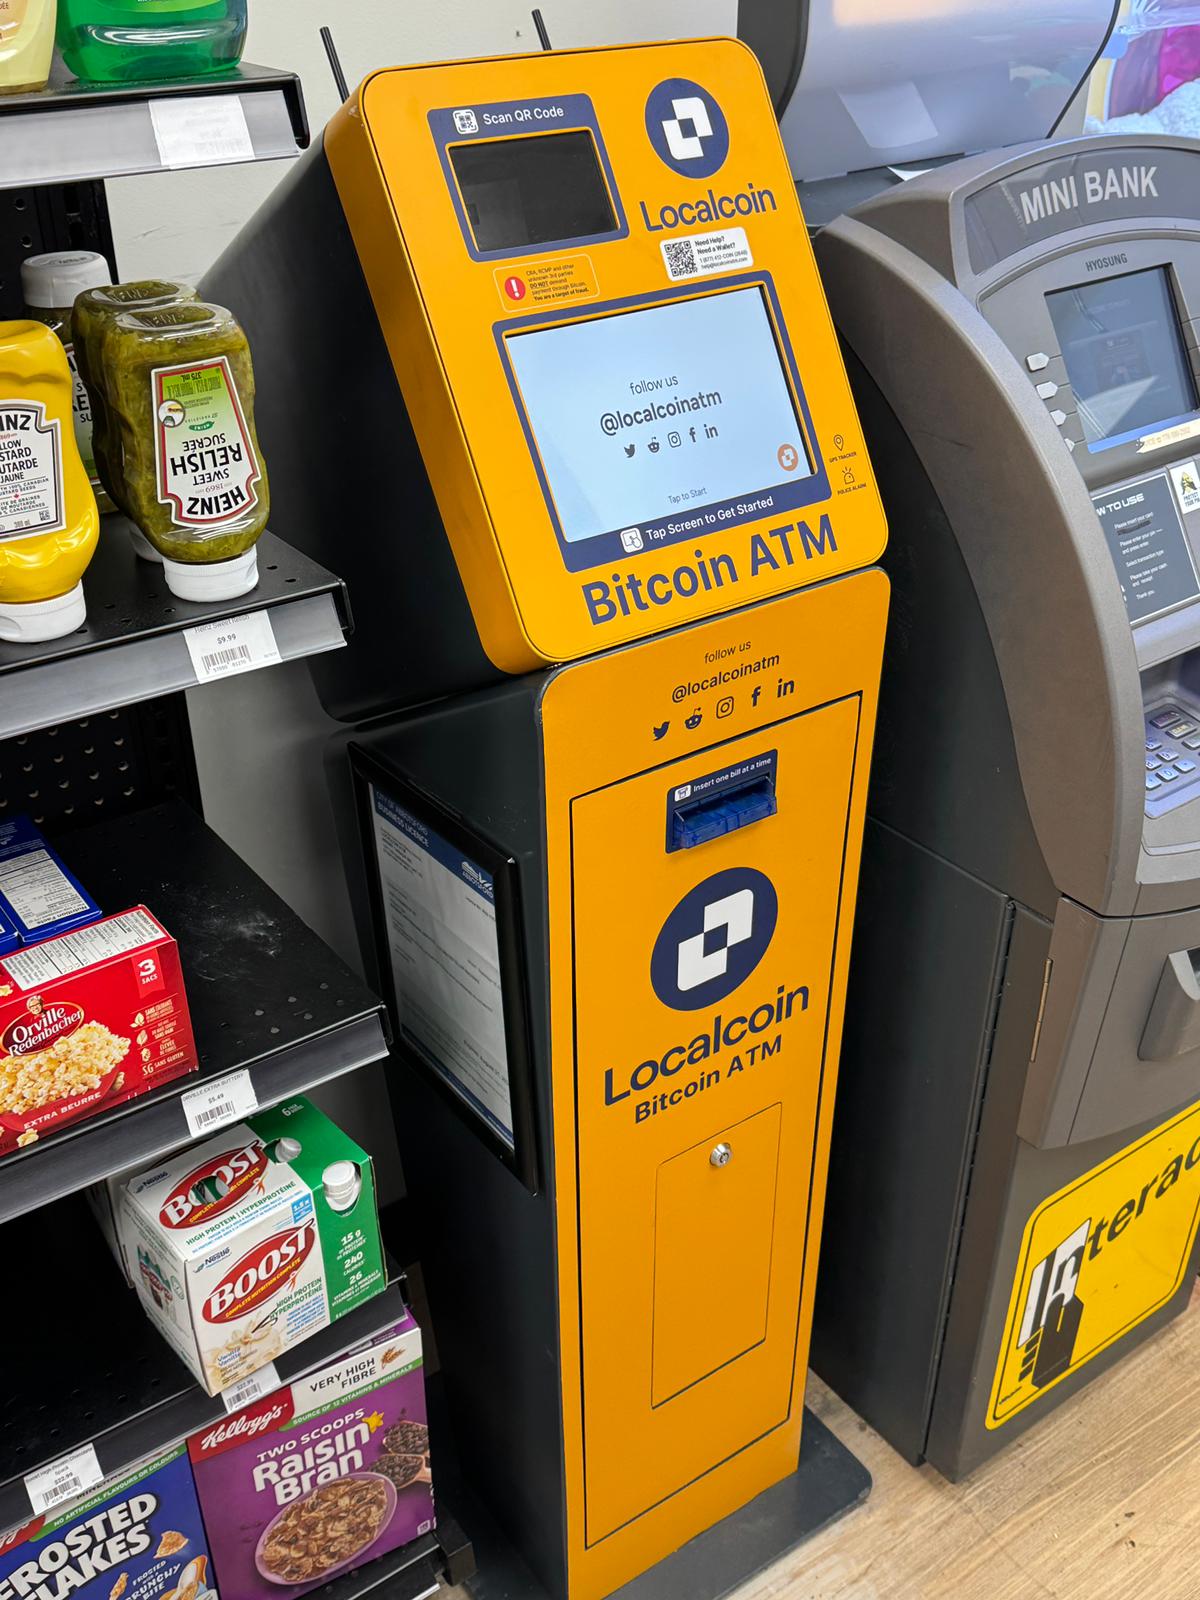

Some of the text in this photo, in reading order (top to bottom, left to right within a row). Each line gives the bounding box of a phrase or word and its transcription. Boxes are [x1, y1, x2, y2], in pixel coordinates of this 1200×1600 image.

[483, 105, 564, 125] Scan QR Code
[1020, 166, 1159, 225] MINI BANK
[639, 183, 777, 232] Localcoin
[694, 239, 710, 247] Need
[697, 247, 712, 255] Need
[1085, 253, 1128, 272] HYOSUNG
[190, 371, 202, 380] 375
[629, 375, 679, 395] follow us
[0, 413, 31, 431] INZ
[600, 391, 722, 436] @localcoinatm
[182, 433, 226, 453] SUCRÉE
[0, 447, 32, 462] STARD
[170, 443, 243, 476] RELISH
[0, 458, 39, 474] UTARDE
[0, 472, 25, 484] JAUNE
[193, 468, 230, 486] SWEET
[205, 483, 223, 493] 1869
[668, 487, 708, 504] Tap to Start
[187, 485, 246, 515] HEINZ
[1106, 493, 1145, 512] TO USE
[645, 496, 774, 541] Tap Screen to Get Started
[581, 513, 838, 626] Bitcoin ATM
[217, 633, 237, 644] $9.99
[704, 641, 752, 664] follow us
[672, 654, 780, 703] @localcoinatm
[693, 779, 714, 792] Insert
[715, 774, 730, 783] one
[730, 768, 741, 778] bill
[742, 765, 749, 774] at
[756, 758, 772, 768] time
[137, 959, 156, 977] 3
[141, 974, 158, 985] SACS
[8, 1011, 81, 1057] Redenbacher
[12, 1008, 66, 1043] Orville
[605, 984, 809, 1106] Localcoin
[142, 1062, 154, 1076] SG
[155, 1059, 167, 1068] SANS
[635, 1034, 782, 1124] Bitcoin ATM
[208, 1093, 224, 1104] $5.49
[23, 1111, 58, 1129] EXTRA
[60, 1091, 102, 1113] BEURRE
[282, 1107, 290, 1117] 6
[143, 1171, 168, 1187] Nestlé
[185, 1232, 205, 1246] HIGH
[206, 1216, 235, 1236] PROTEIN
[341, 1232, 353, 1244] 15
[204, 1247, 231, 1265] Nestlé
[344, 1251, 363, 1269] 240
[210, 1218, 315, 1320] BOOST
[349, 1271, 362, 1284] 26
[276, 1277, 322, 1308] HIGH PROTEIN
[225, 1298, 250, 1318] COMPLETE
[310, 1357, 375, 1392] VERY HIGH
[341, 1366, 377, 1389] FIBRE
[293, 1407, 321, 1426] SOURCE
[322, 1404, 333, 1412] OF
[341, 1384, 373, 1404] VITAMINS
[380, 1364, 414, 1385] MINERALS
[201, 1402, 283, 1450] Kellogg's
[257, 1409, 365, 1462] TWO SCOOPS
[252, 1422, 370, 1492] Raisin
[274, 1450, 363, 1505] Bran
[54, 1518, 64, 1527] NO
[65, 1497, 103, 1522] ARTIFICIAL
[103, 1478, 138, 1498] FLAVOURS
[138, 1470, 148, 1479] OR
[149, 1451, 178, 1471] COLOURS
[0, 1493, 157, 1600] FROSTED
